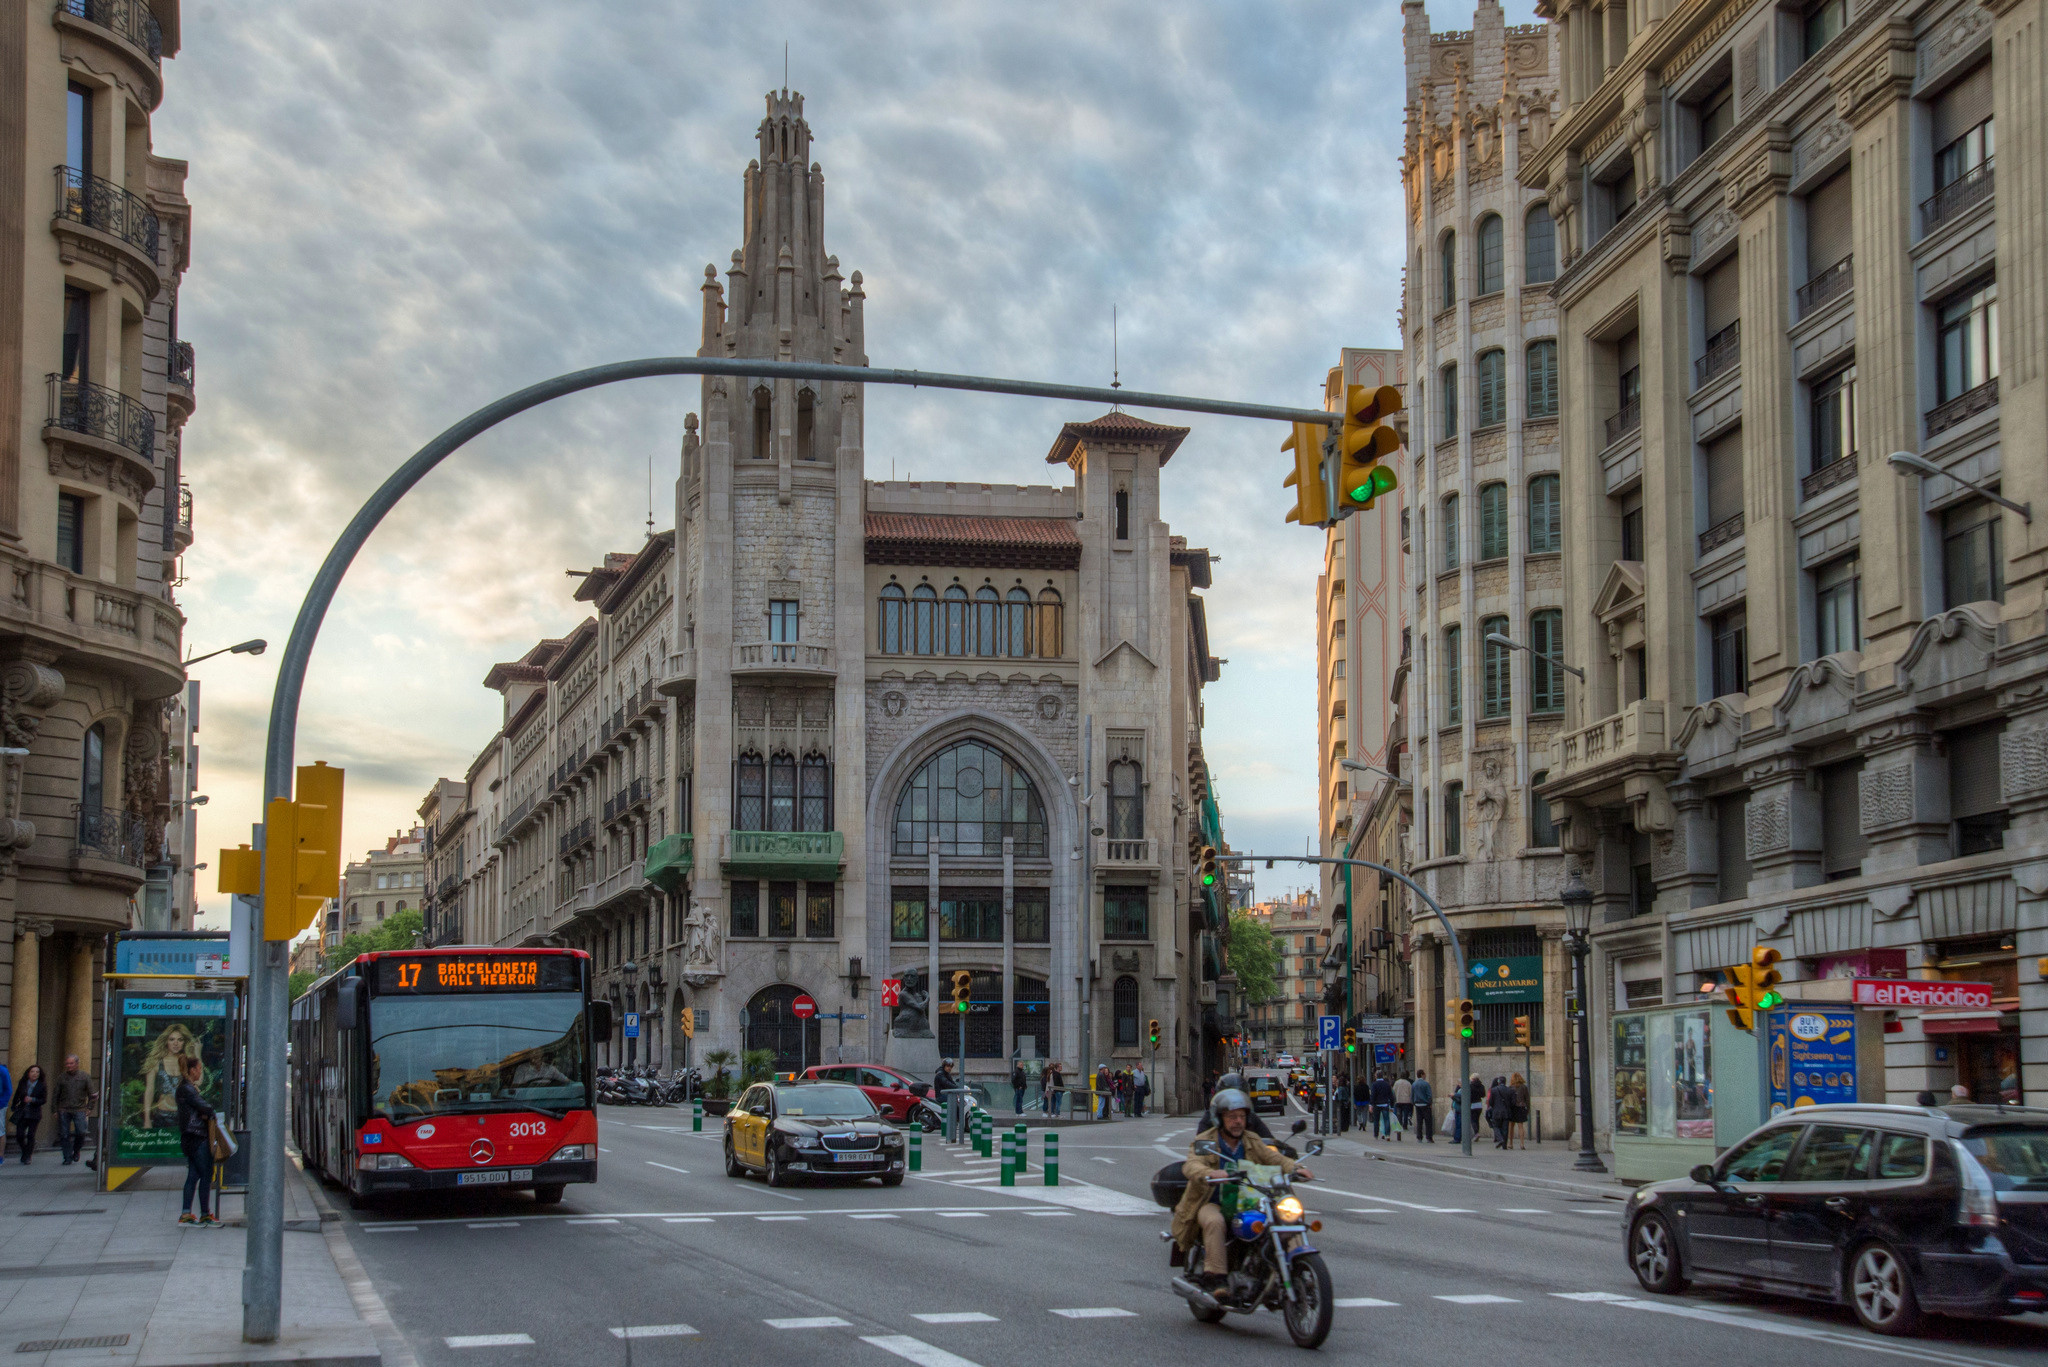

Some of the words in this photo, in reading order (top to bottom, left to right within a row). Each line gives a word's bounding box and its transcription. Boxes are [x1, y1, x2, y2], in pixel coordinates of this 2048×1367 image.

[438, 961, 537, 975] BARCELONETA
[398, 963, 422, 987] 17
[439, 974, 473, 986] VALL
[480, 973, 536, 985] HEBRON
[1474, 980, 1497, 988] NÚÑEZ
[1503, 979, 1538, 987] NAVARRO
[1895, 985, 1989, 1007] Periódico
[128, 1002, 140, 1010] Tot
[142, 1002, 182, 1010] Barcelona
[1800, 1017, 1817, 1026] BUY
[1323, 1019, 1336, 1036] P
[1797, 1026, 1819, 1035] HERE
[1792, 1051, 1835, 1062] Sightseeing
[509, 1121, 547, 1137] 3013
[838, 1152, 858, 1162] 8198
[858, 1152, 872, 1161] GXX
[463, 1173, 487, 1184] 9515
